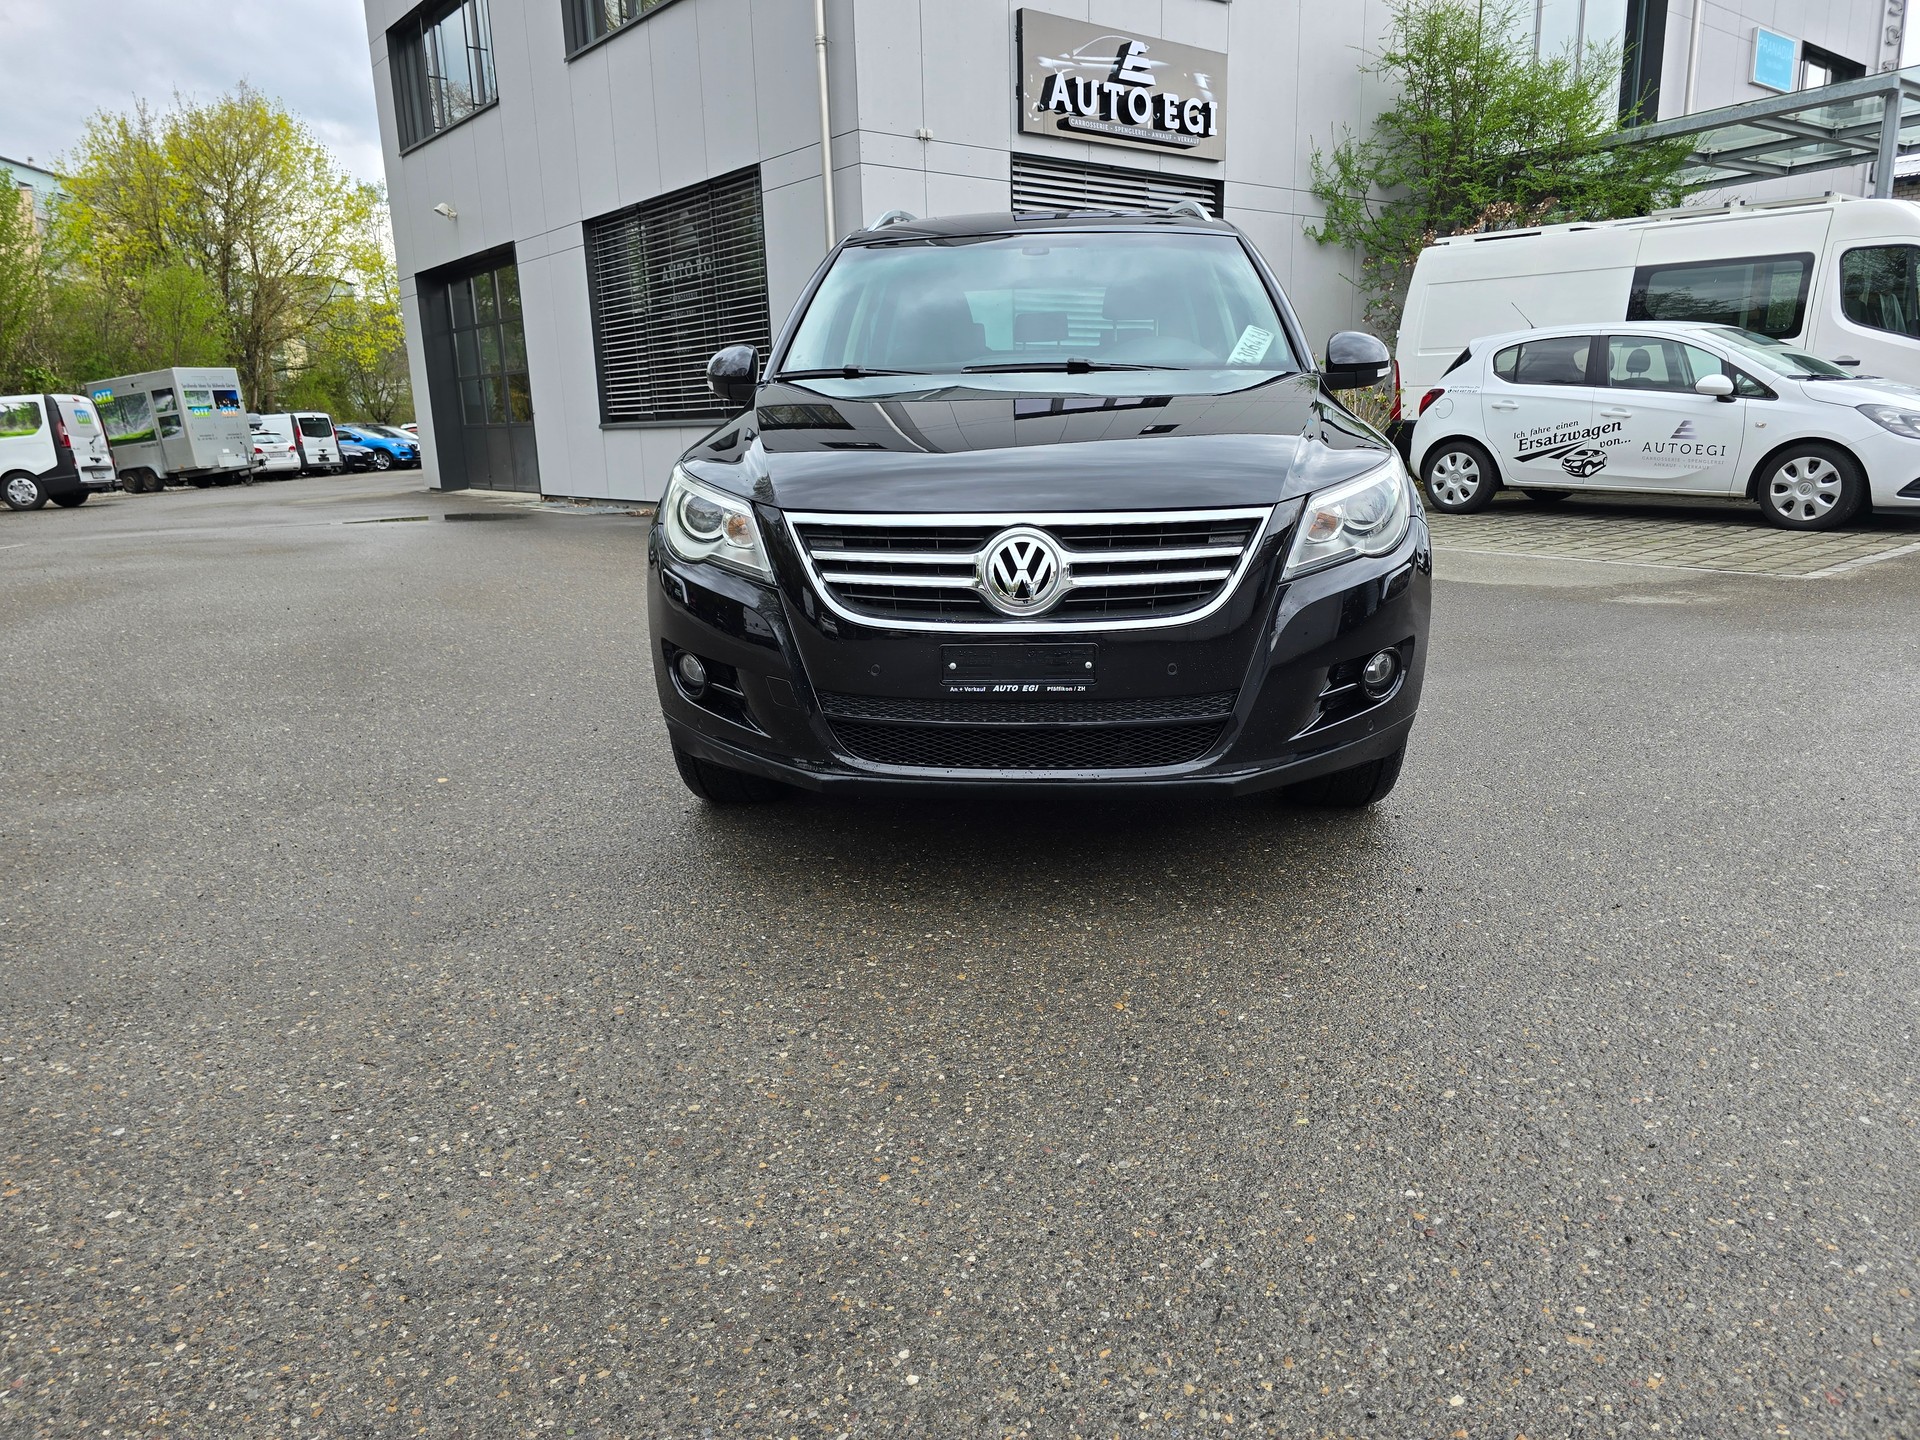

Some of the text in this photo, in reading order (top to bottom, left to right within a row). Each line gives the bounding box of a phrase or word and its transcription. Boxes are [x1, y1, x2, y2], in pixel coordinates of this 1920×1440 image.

[1046, 71, 1218, 137] AUTO EGI
[1070, 118, 1109, 131] CARROSSERIE
[1114, 125, 1147, 136] SPENGLEREI
[1151, 132, 1172, 140] ANKAUF
[1177, 136, 1200, 145] VERKAUF
[1513, 420, 1579, 440] Ich fahre einen
[1518, 421, 1622, 452] Ersatzwagen
[1599, 437, 1631, 448] von...
[1641, 442, 1726, 457] AUTOEGI
[1641, 455, 1680, 463] CARROSSERIE
[992, 684, 1019, 692] AUTO
[1021, 684, 1040, 692] EGI
